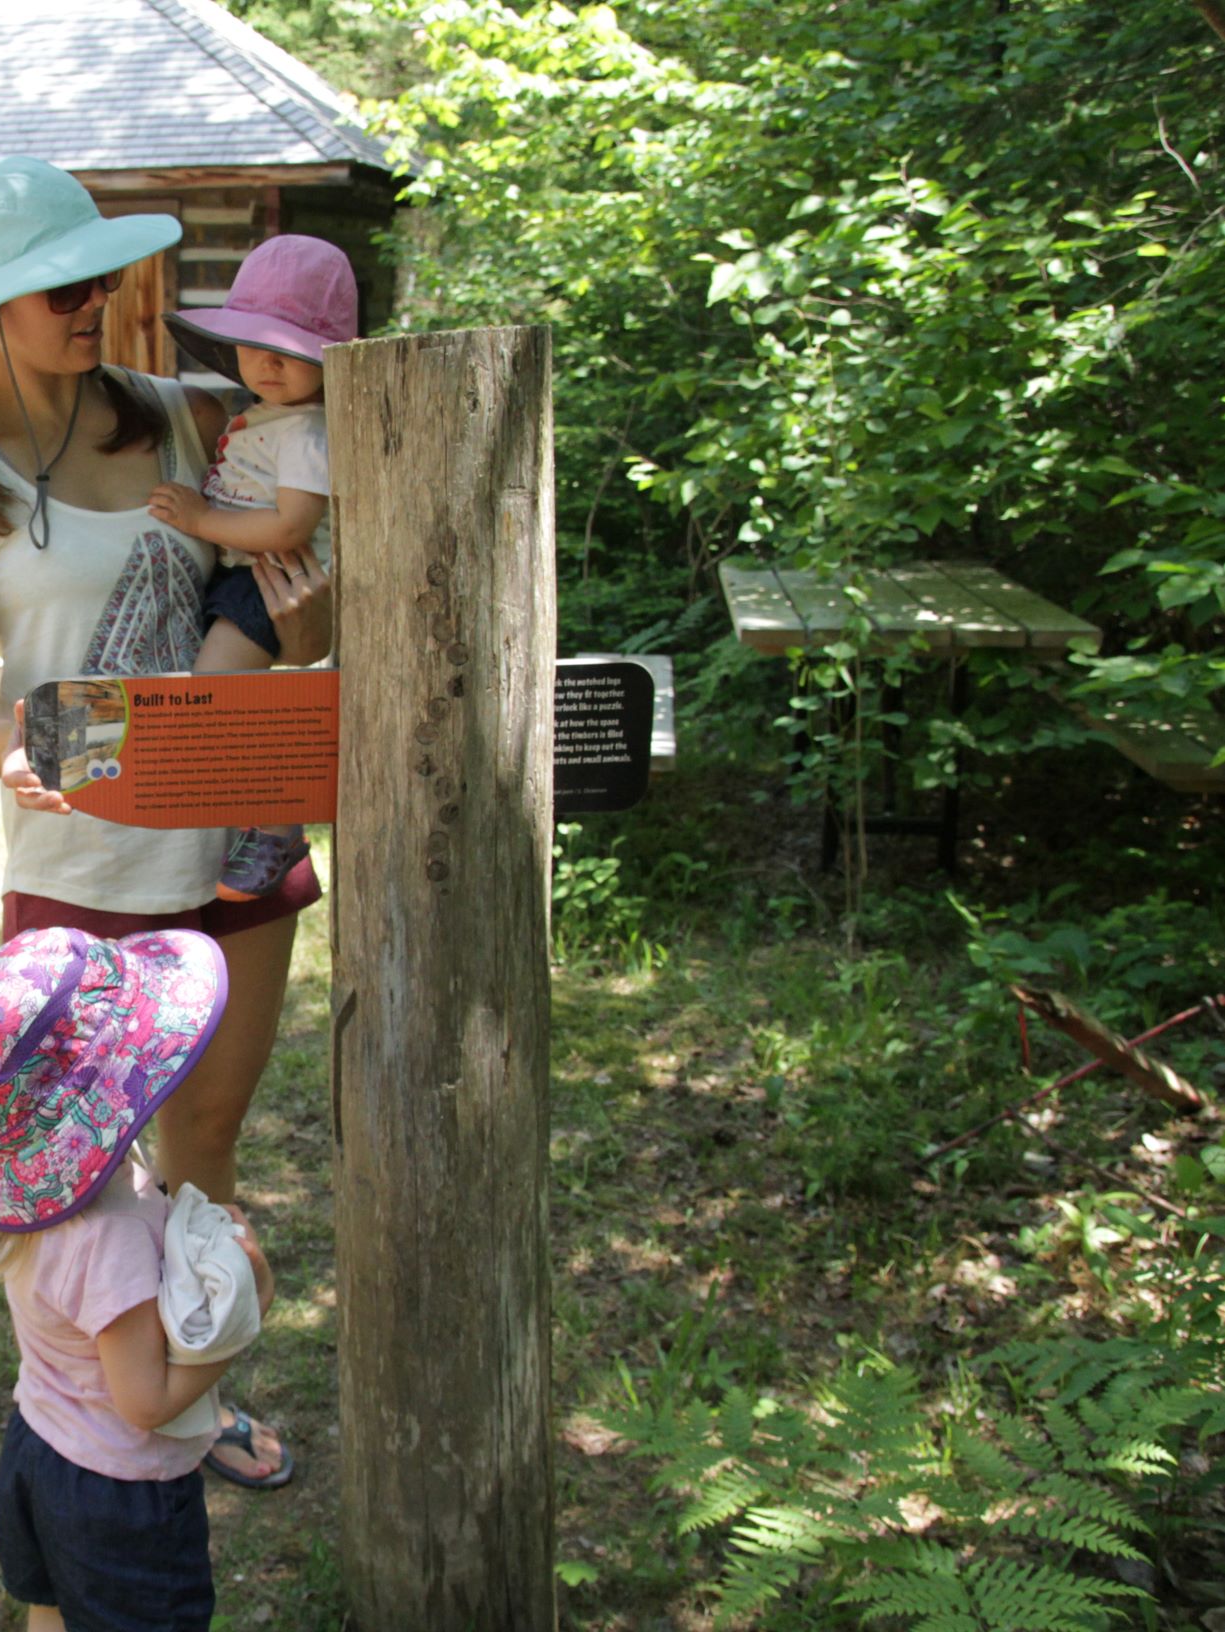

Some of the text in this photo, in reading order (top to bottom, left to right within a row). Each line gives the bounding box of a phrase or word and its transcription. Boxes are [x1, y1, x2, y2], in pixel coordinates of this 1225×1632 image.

[564, 677, 575, 687] the
[134, 691, 213, 707] Built to Last
[566, 690, 583, 700] they
[584, 689, 593, 699] fit
[579, 702, 591, 710] like
[560, 720, 568, 728] at
[569, 718, 585, 727] how
[587, 718, 599, 727] the
[558, 731, 570, 740] the
[571, 731, 599, 740] timbers
[575, 744, 583, 752] to
[584, 743, 601, 753] keep
[602, 743, 614, 751] out
[615, 742, 627, 750] the
[568, 755, 582, 765] and
[583, 754, 602, 763] small
